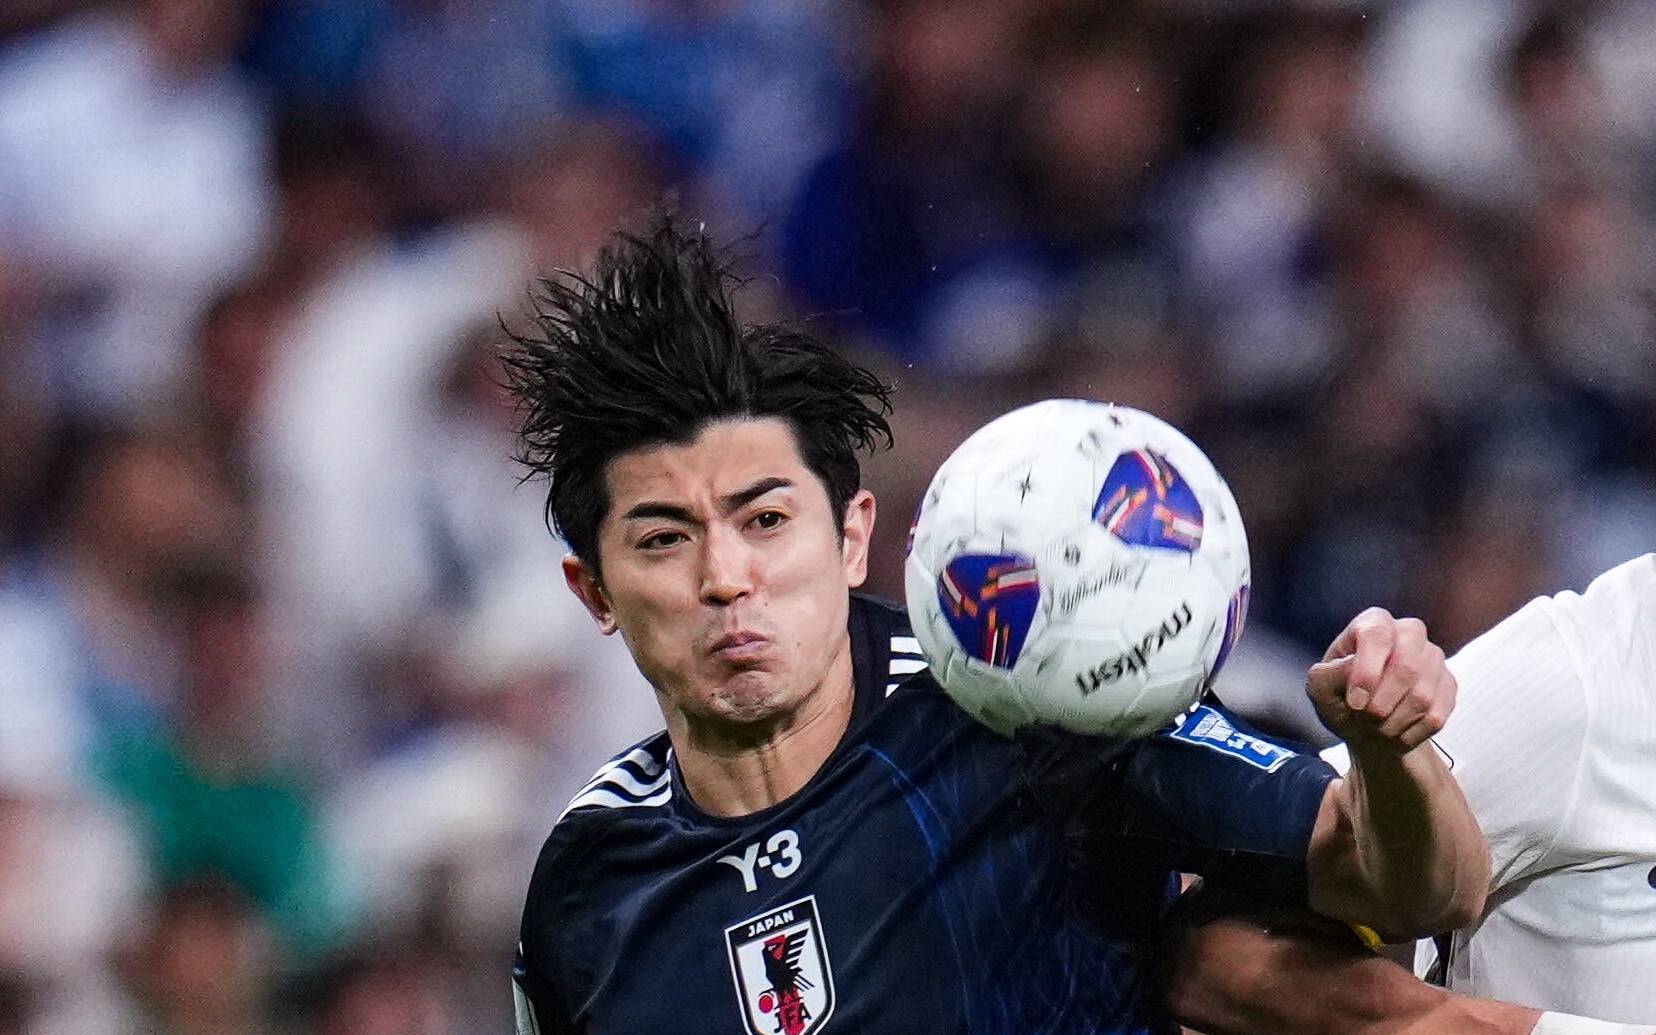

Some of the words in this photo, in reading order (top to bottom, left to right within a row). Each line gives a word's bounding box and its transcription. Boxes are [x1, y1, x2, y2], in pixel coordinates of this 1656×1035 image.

[1074, 600, 1193, 697] molten
[716, 829, 802, 892] Y-3
[748, 910, 795, 937] JAPAN
